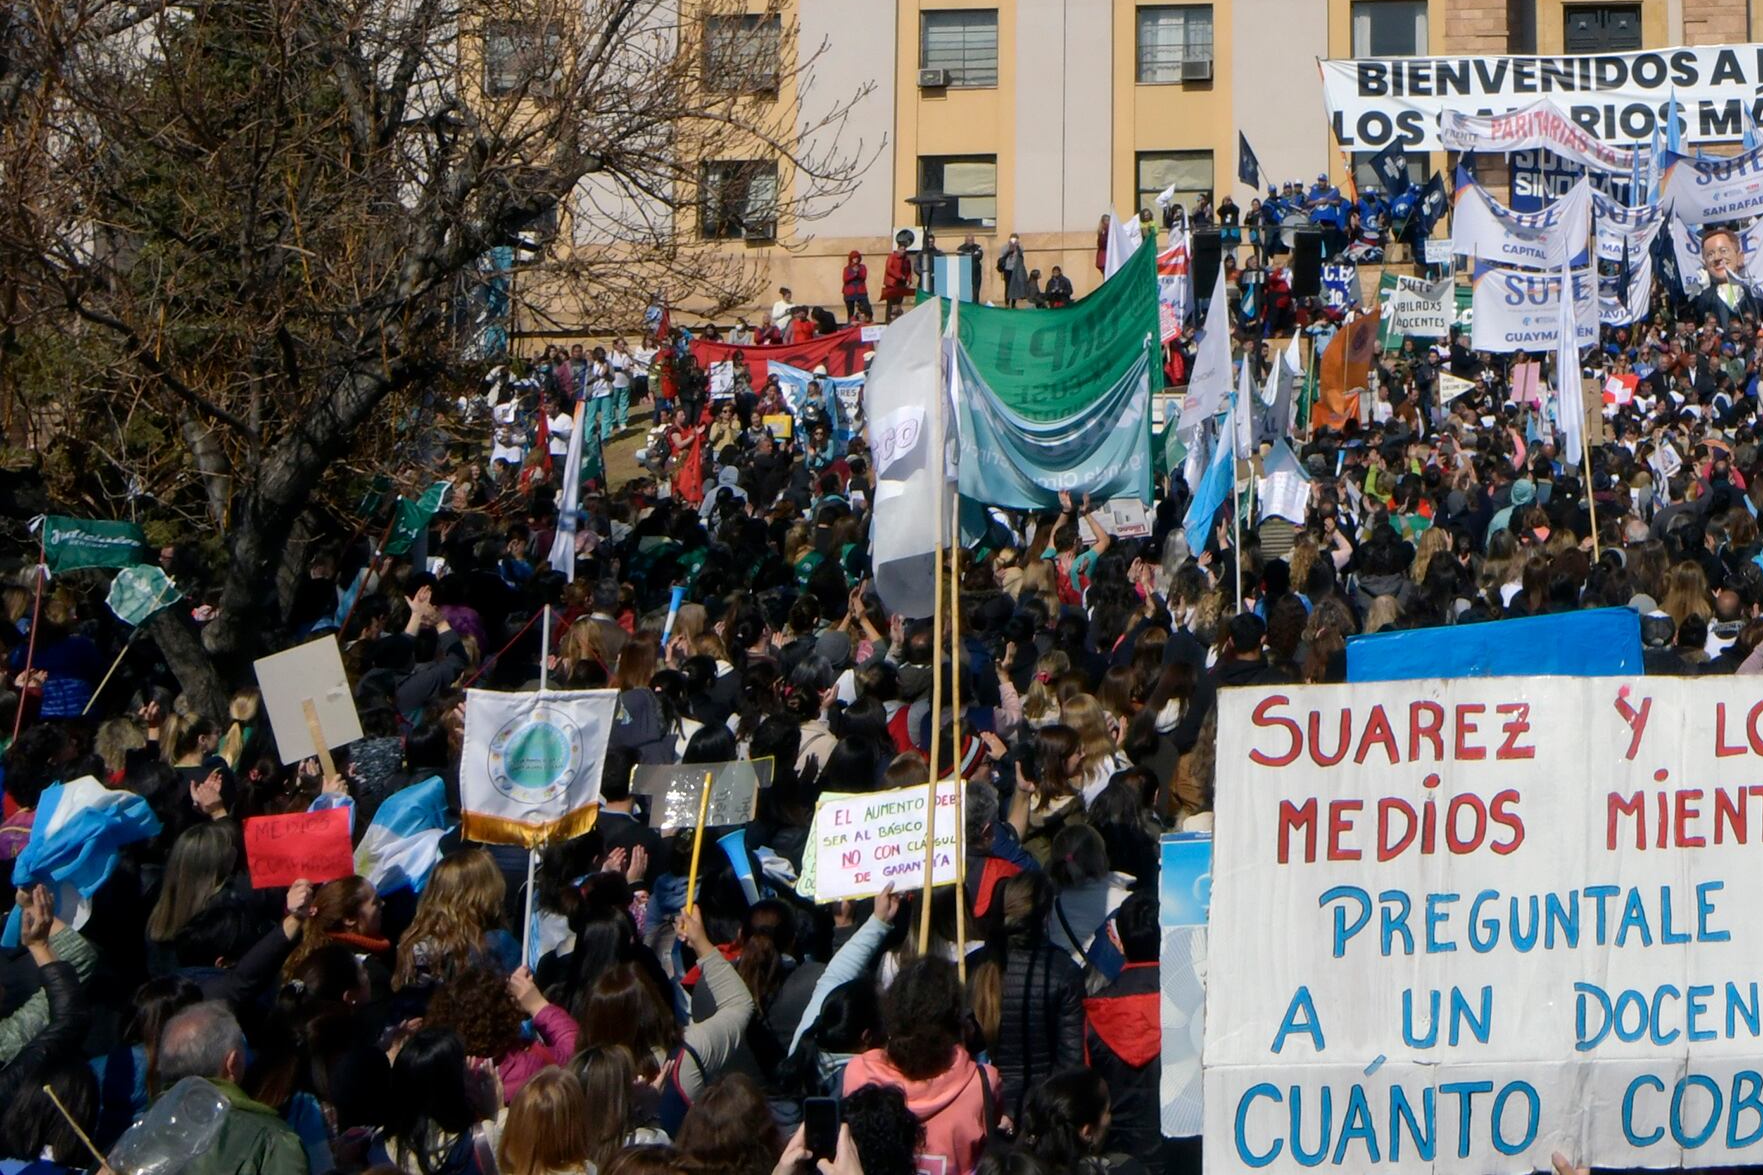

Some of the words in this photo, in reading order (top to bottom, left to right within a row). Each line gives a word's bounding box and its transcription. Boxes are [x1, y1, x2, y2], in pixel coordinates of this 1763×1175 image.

[1357, 51, 1699, 97] BIENVENIDOS
[1710, 49, 1747, 86] A
[1332, 110, 1425, 147] LOS
[1490, 110, 1588, 153] PARITARIAS
[1702, 206, 1727, 218] SAN
[1502, 243, 1547, 260] CAPITAL
[1601, 242, 1641, 256] MAPÚ
[1504, 324, 1594, 343] GUAYMAÉN
[1249, 694, 1536, 767] SUAREZ
[1614, 695, 1653, 761] Y
[834, 808, 853, 826] EL
[864, 797, 925, 822] AUMENTO
[934, 794, 962, 806] DEB
[823, 834, 848, 847] SER
[854, 830, 872, 843] AL
[878, 820, 923, 838] BÁSICO
[842, 849, 861, 867] NO
[873, 843, 901, 861] CON
[906, 831, 958, 852] CLÁSUL
[854, 871, 872, 884] DE
[882, 852, 950, 877] GARANÍA
[1318, 880, 1731, 958] PREGUNTALE
[1270, 985, 1326, 1054] A
[1402, 984, 1493, 1048] UN
[1233, 1053, 1541, 1168] CUÁNTO
